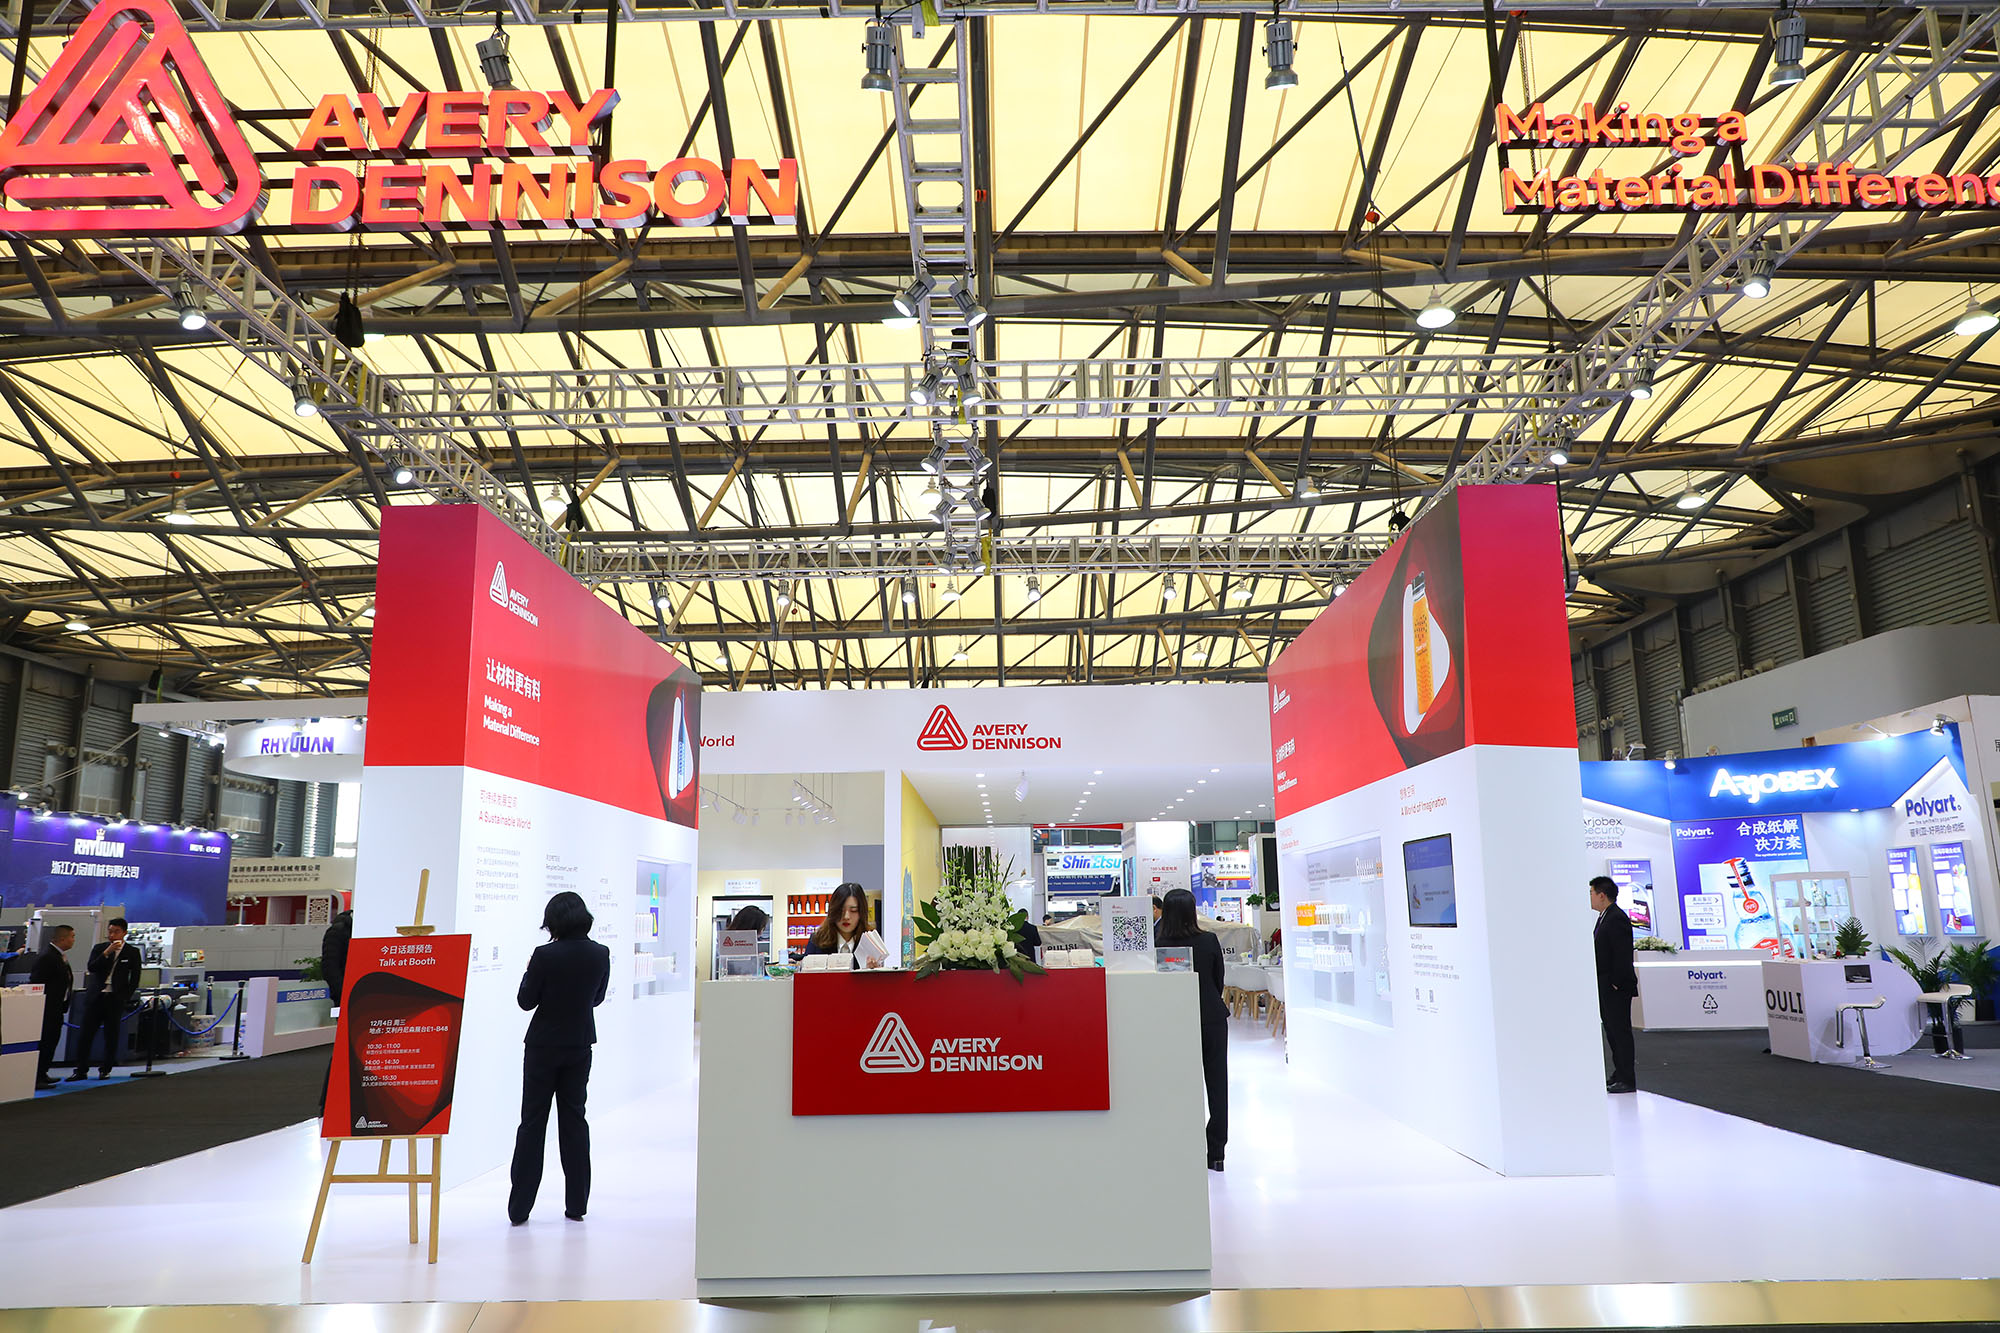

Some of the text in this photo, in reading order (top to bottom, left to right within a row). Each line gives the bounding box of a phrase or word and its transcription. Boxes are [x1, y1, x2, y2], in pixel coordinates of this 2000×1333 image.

[294, 88, 620, 156] AVERY
[1495, 102, 1748, 157] Making a
[290, 157, 798, 229] DENNISON
[1501, 163, 1738, 212] Material
[509, 588, 529, 608] AVERY
[508, 599, 539, 627] DENNISON
[486, 656, 541, 702] 让材料更有料
[484, 694, 508, 719] Making
[482, 714, 540, 746] Material Difference
[972, 723, 1029, 736] AVERY
[972, 737, 1062, 750] DENNISON
[1737, 819, 1800, 836] 合成纸解
[1754, 834, 1803, 852] 决方案
[51, 860, 140, 879] 浙江力冠机械有限公司
[380, 944, 433, 955] 今日话题预告
[378, 958, 396, 967] Talk
[409, 957, 436, 966] Booth
[1766, 989, 1804, 1014] OULI
[370, 1019, 393, 1027] 12月4日
[929, 1037, 1002, 1054] AVERY
[929, 1055, 1043, 1073] DENNISON
